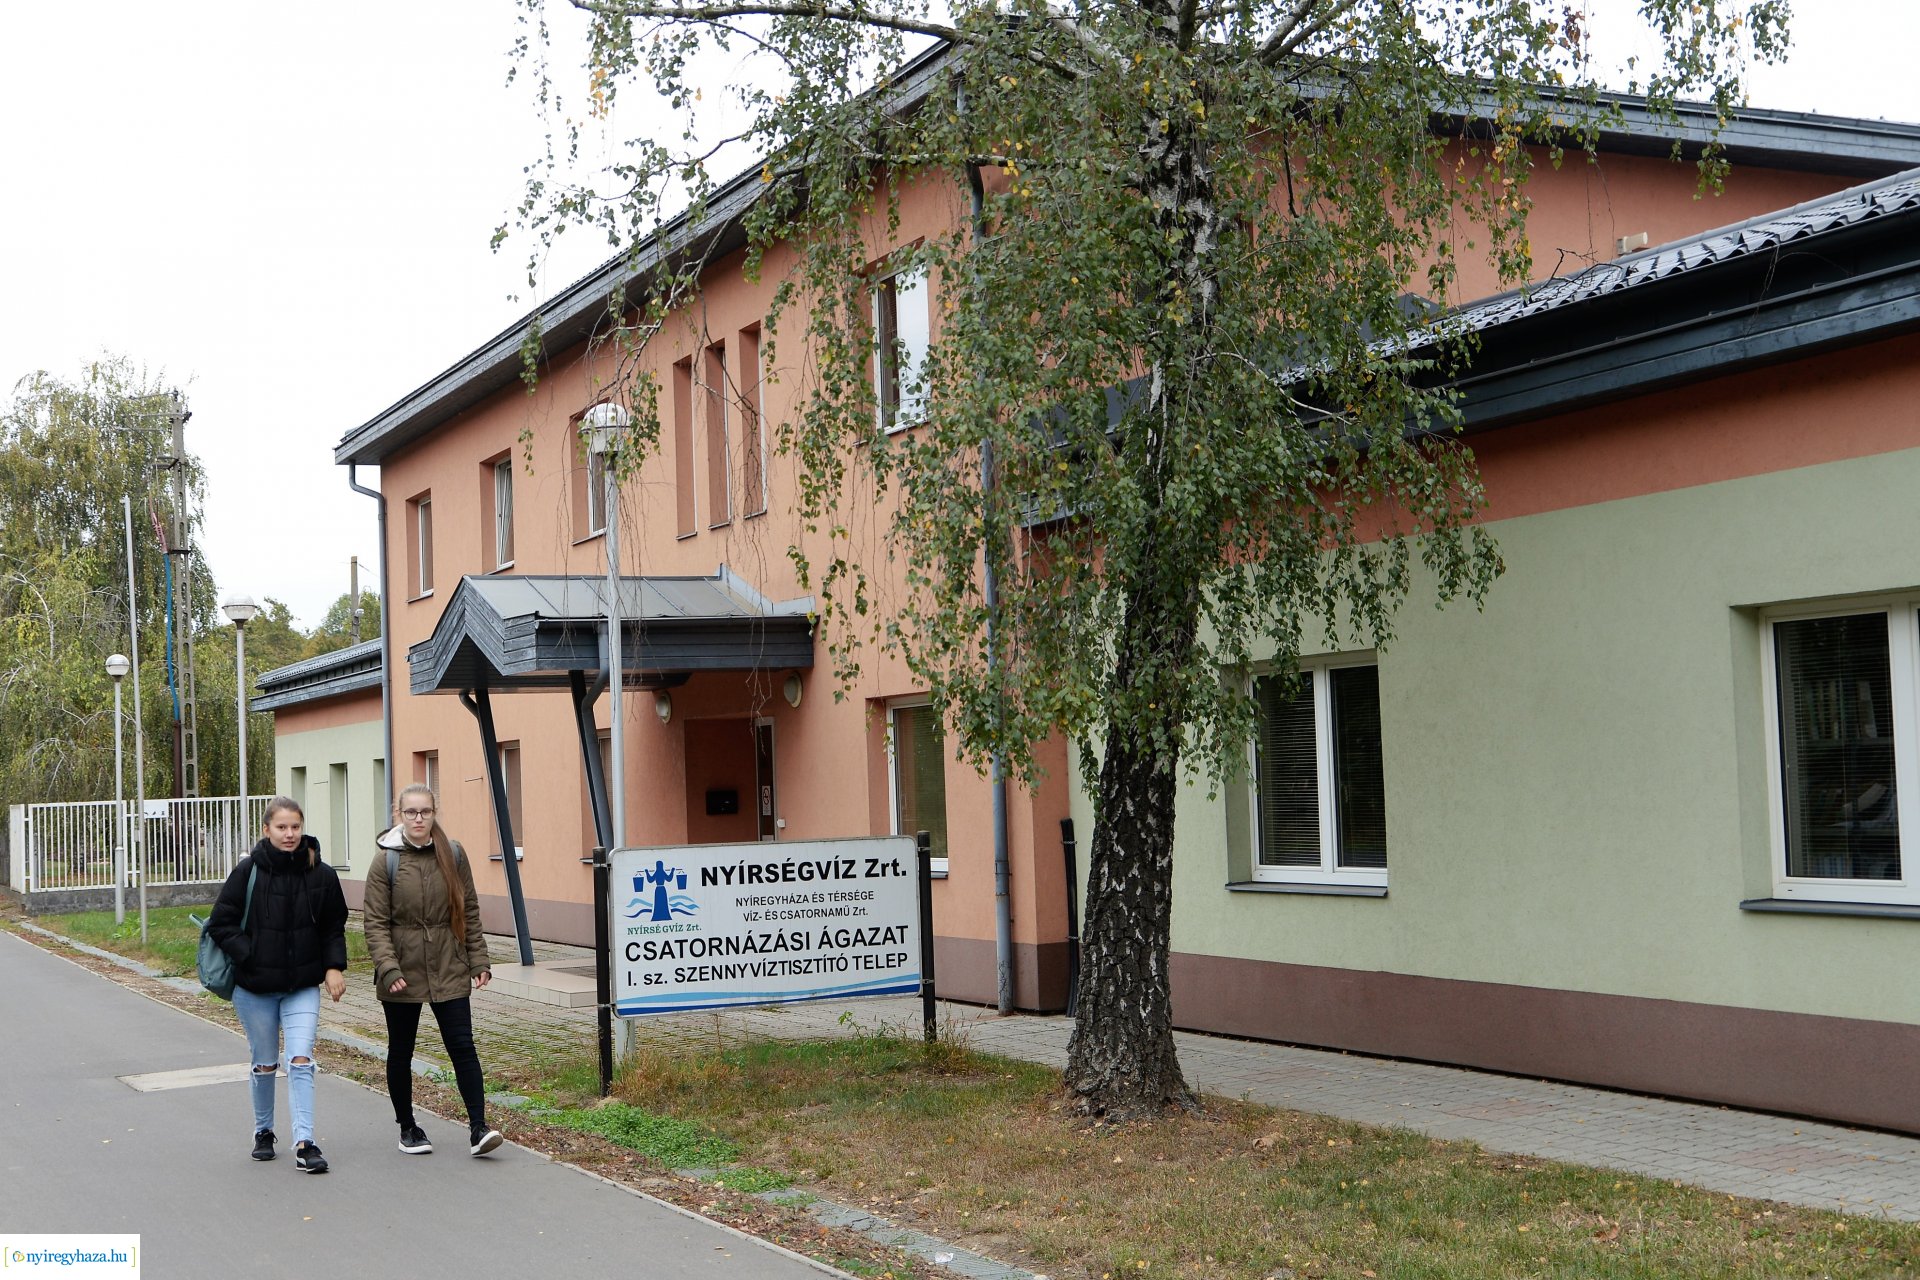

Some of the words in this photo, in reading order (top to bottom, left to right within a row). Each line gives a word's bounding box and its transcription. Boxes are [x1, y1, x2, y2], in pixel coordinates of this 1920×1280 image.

[701, 855, 857, 887] NYÍRSÉGVÍZ
[864, 857, 907, 878] Zrt.
[735, 893, 809, 907] NYÍREGYHÁZA
[812, 891, 825, 903] ÉS
[827, 889, 874, 902] TÉRSÉGE
[743, 909, 763, 922] VÍZ-
[765, 908, 778, 921] ÉS
[779, 905, 850, 920] CSATORNAMŰ
[852, 906, 869, 916] Zrt.
[686, 923, 702, 932] Zrt.
[625, 928, 810, 962] CSATORNÁZÁSI
[817, 925, 909, 950] ÁGAZAT
[643, 973, 668, 985] sz.
[674, 953, 849, 983] SZENNYVÍZTISZTÍTÓ
[852, 952, 908, 971] TELEP
